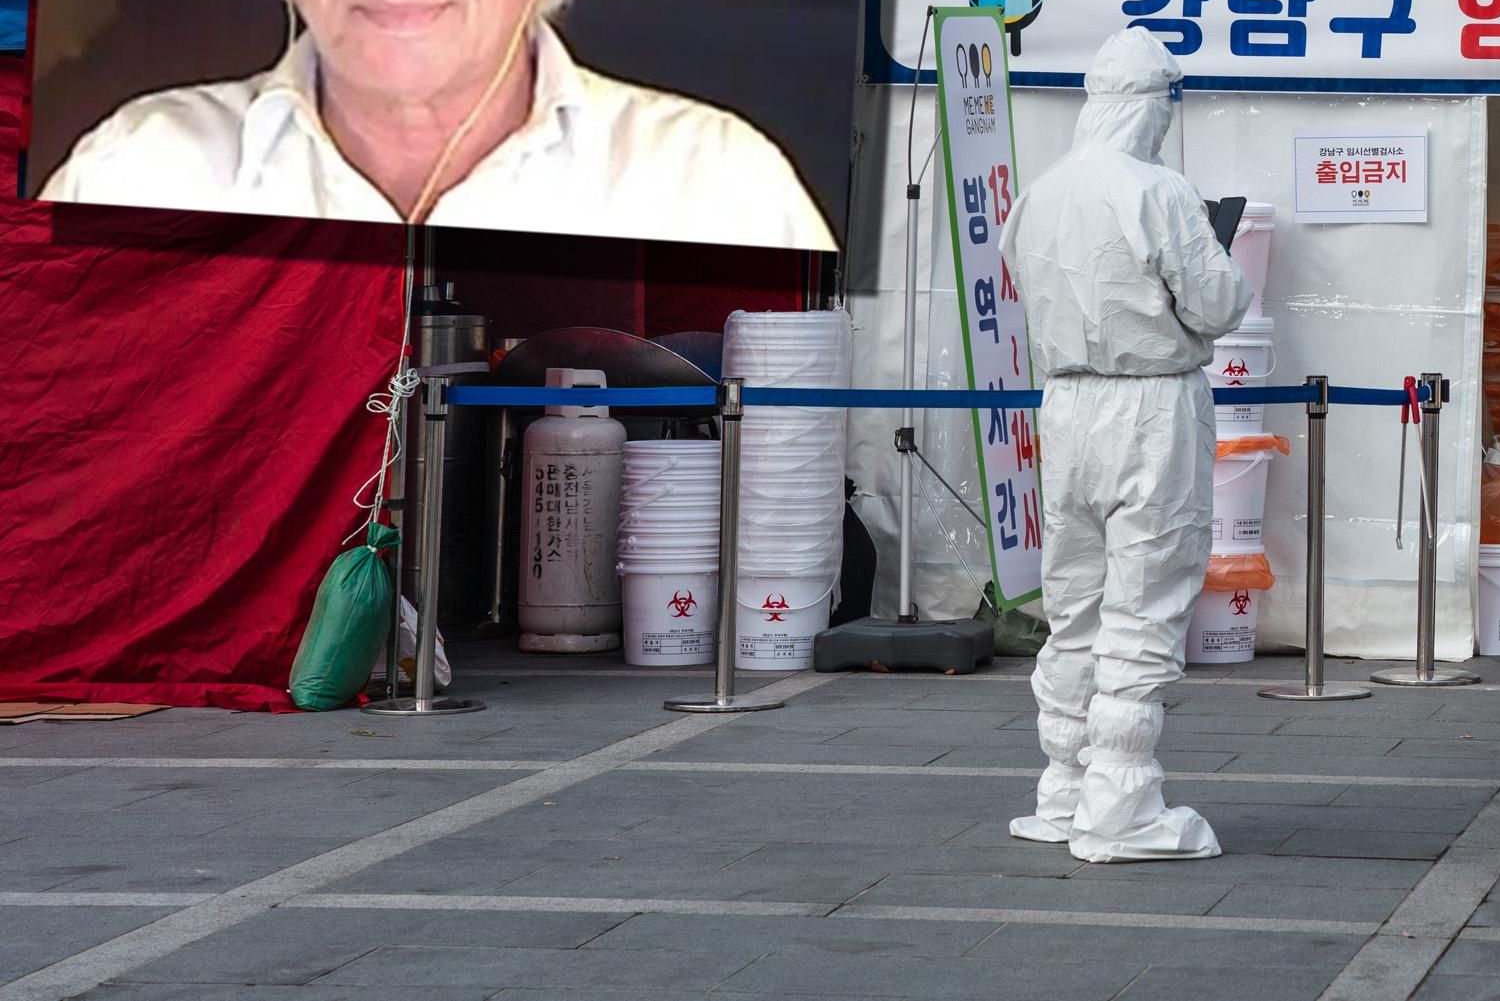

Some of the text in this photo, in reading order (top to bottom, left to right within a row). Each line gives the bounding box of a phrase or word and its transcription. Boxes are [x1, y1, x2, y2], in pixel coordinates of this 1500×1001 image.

[1320, 147, 1404, 156] 강남구 임시선별검사소
[1315, 160, 1407, 184] 출입금지
